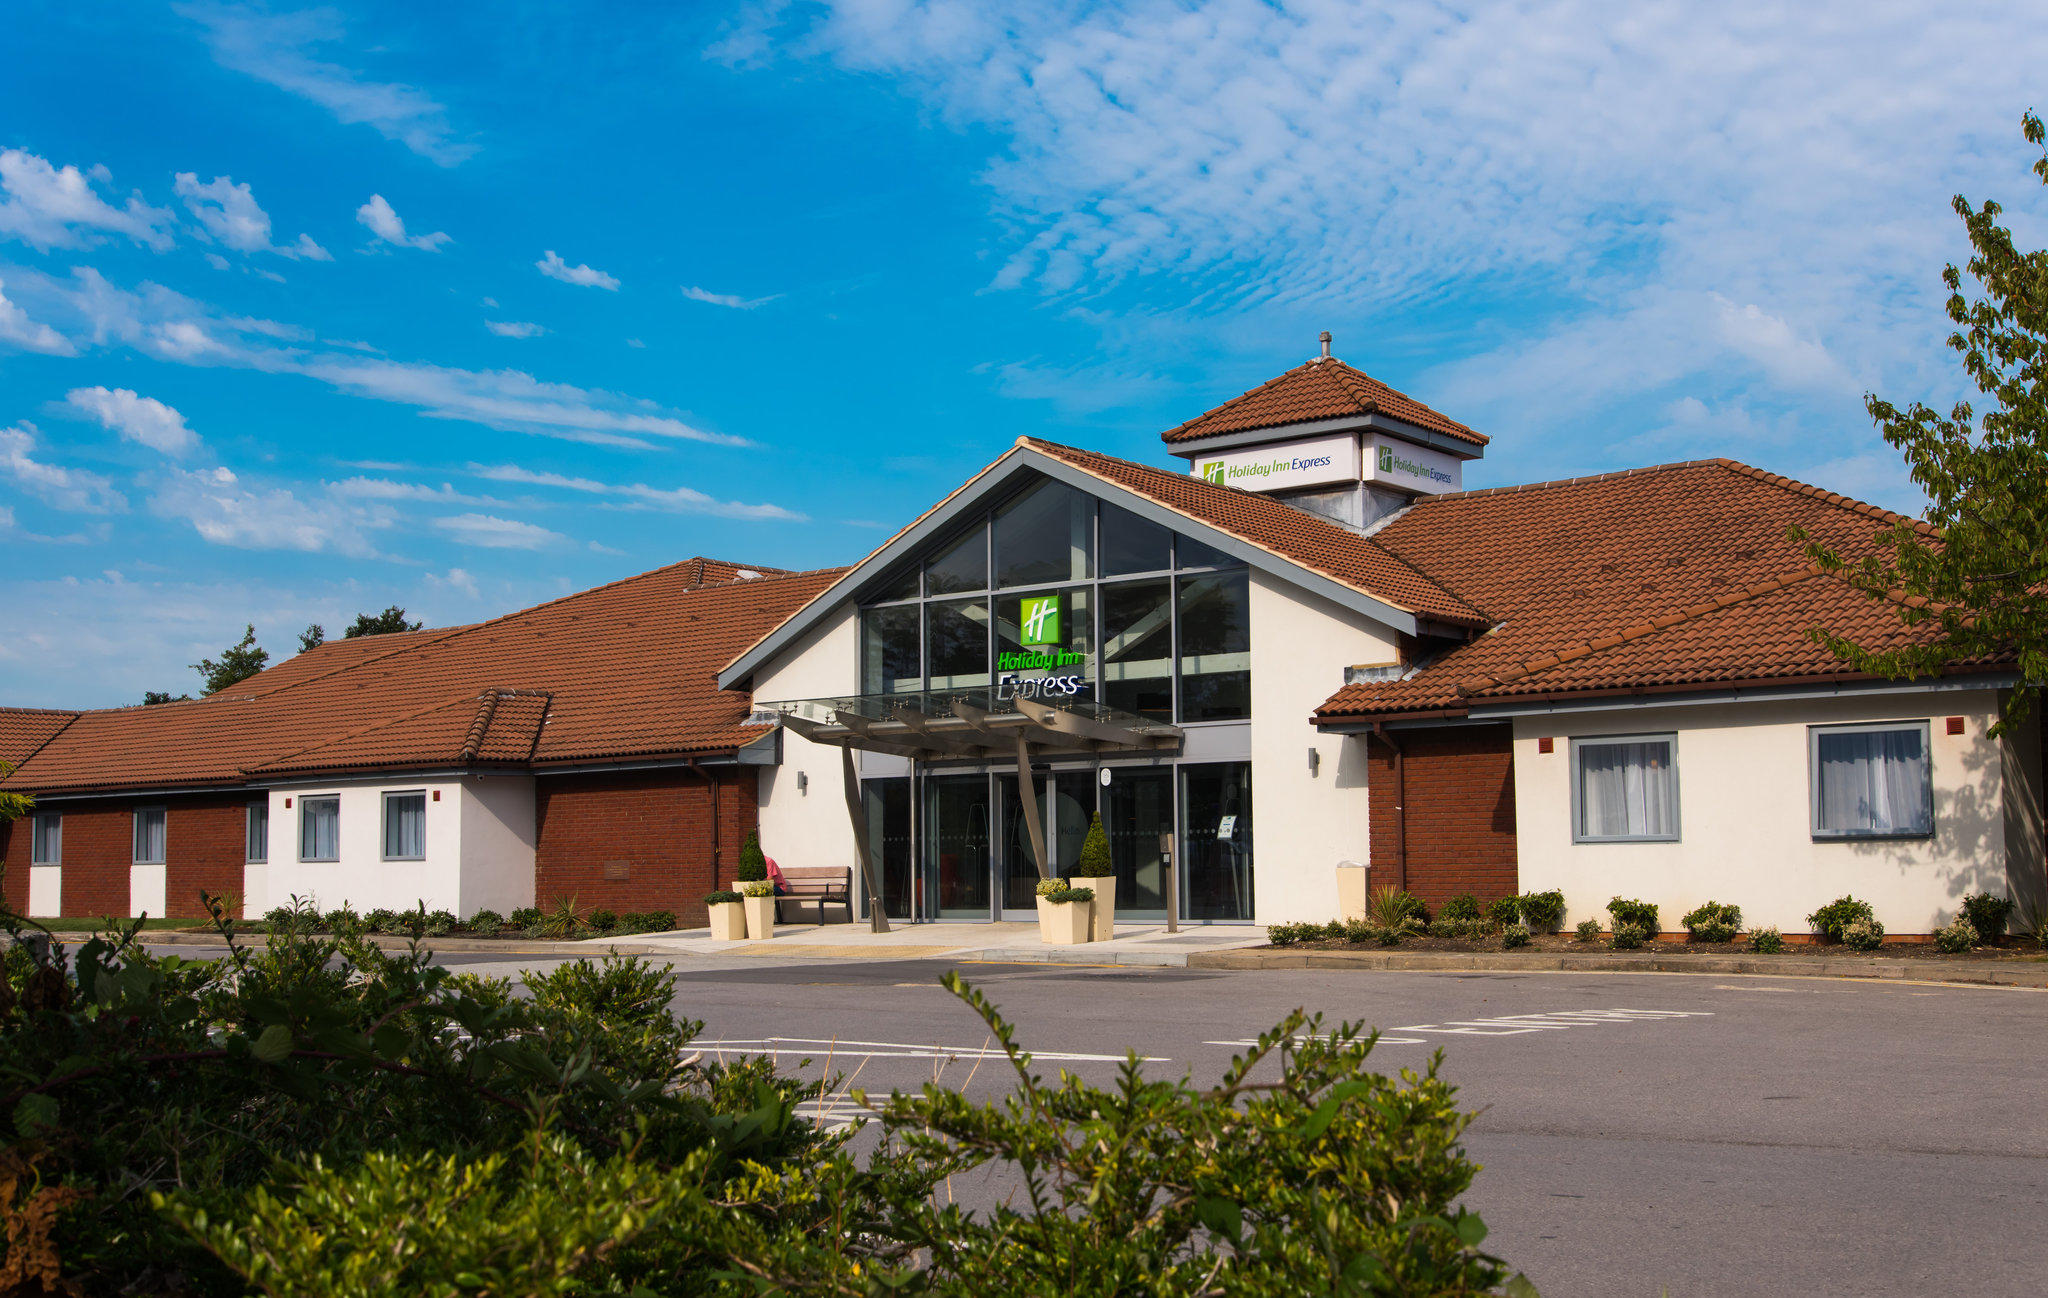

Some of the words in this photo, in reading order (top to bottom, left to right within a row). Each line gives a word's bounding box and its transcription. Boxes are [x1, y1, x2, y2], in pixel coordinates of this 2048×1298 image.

[1228, 462, 1271, 479] Holiday
[1272, 459, 1290, 472] Inn
[1291, 456, 1331, 471] Express
[1394, 456, 1419, 477] Holiday
[1420, 464, 1430, 477] Inn
[1430, 468, 1452, 483] Express
[998, 650, 1054, 671] Holiday
[1057, 648, 1079, 666] Inn
[998, 674, 1078, 700] Express
[1388, 1008, 1715, 1035] ENTRY
